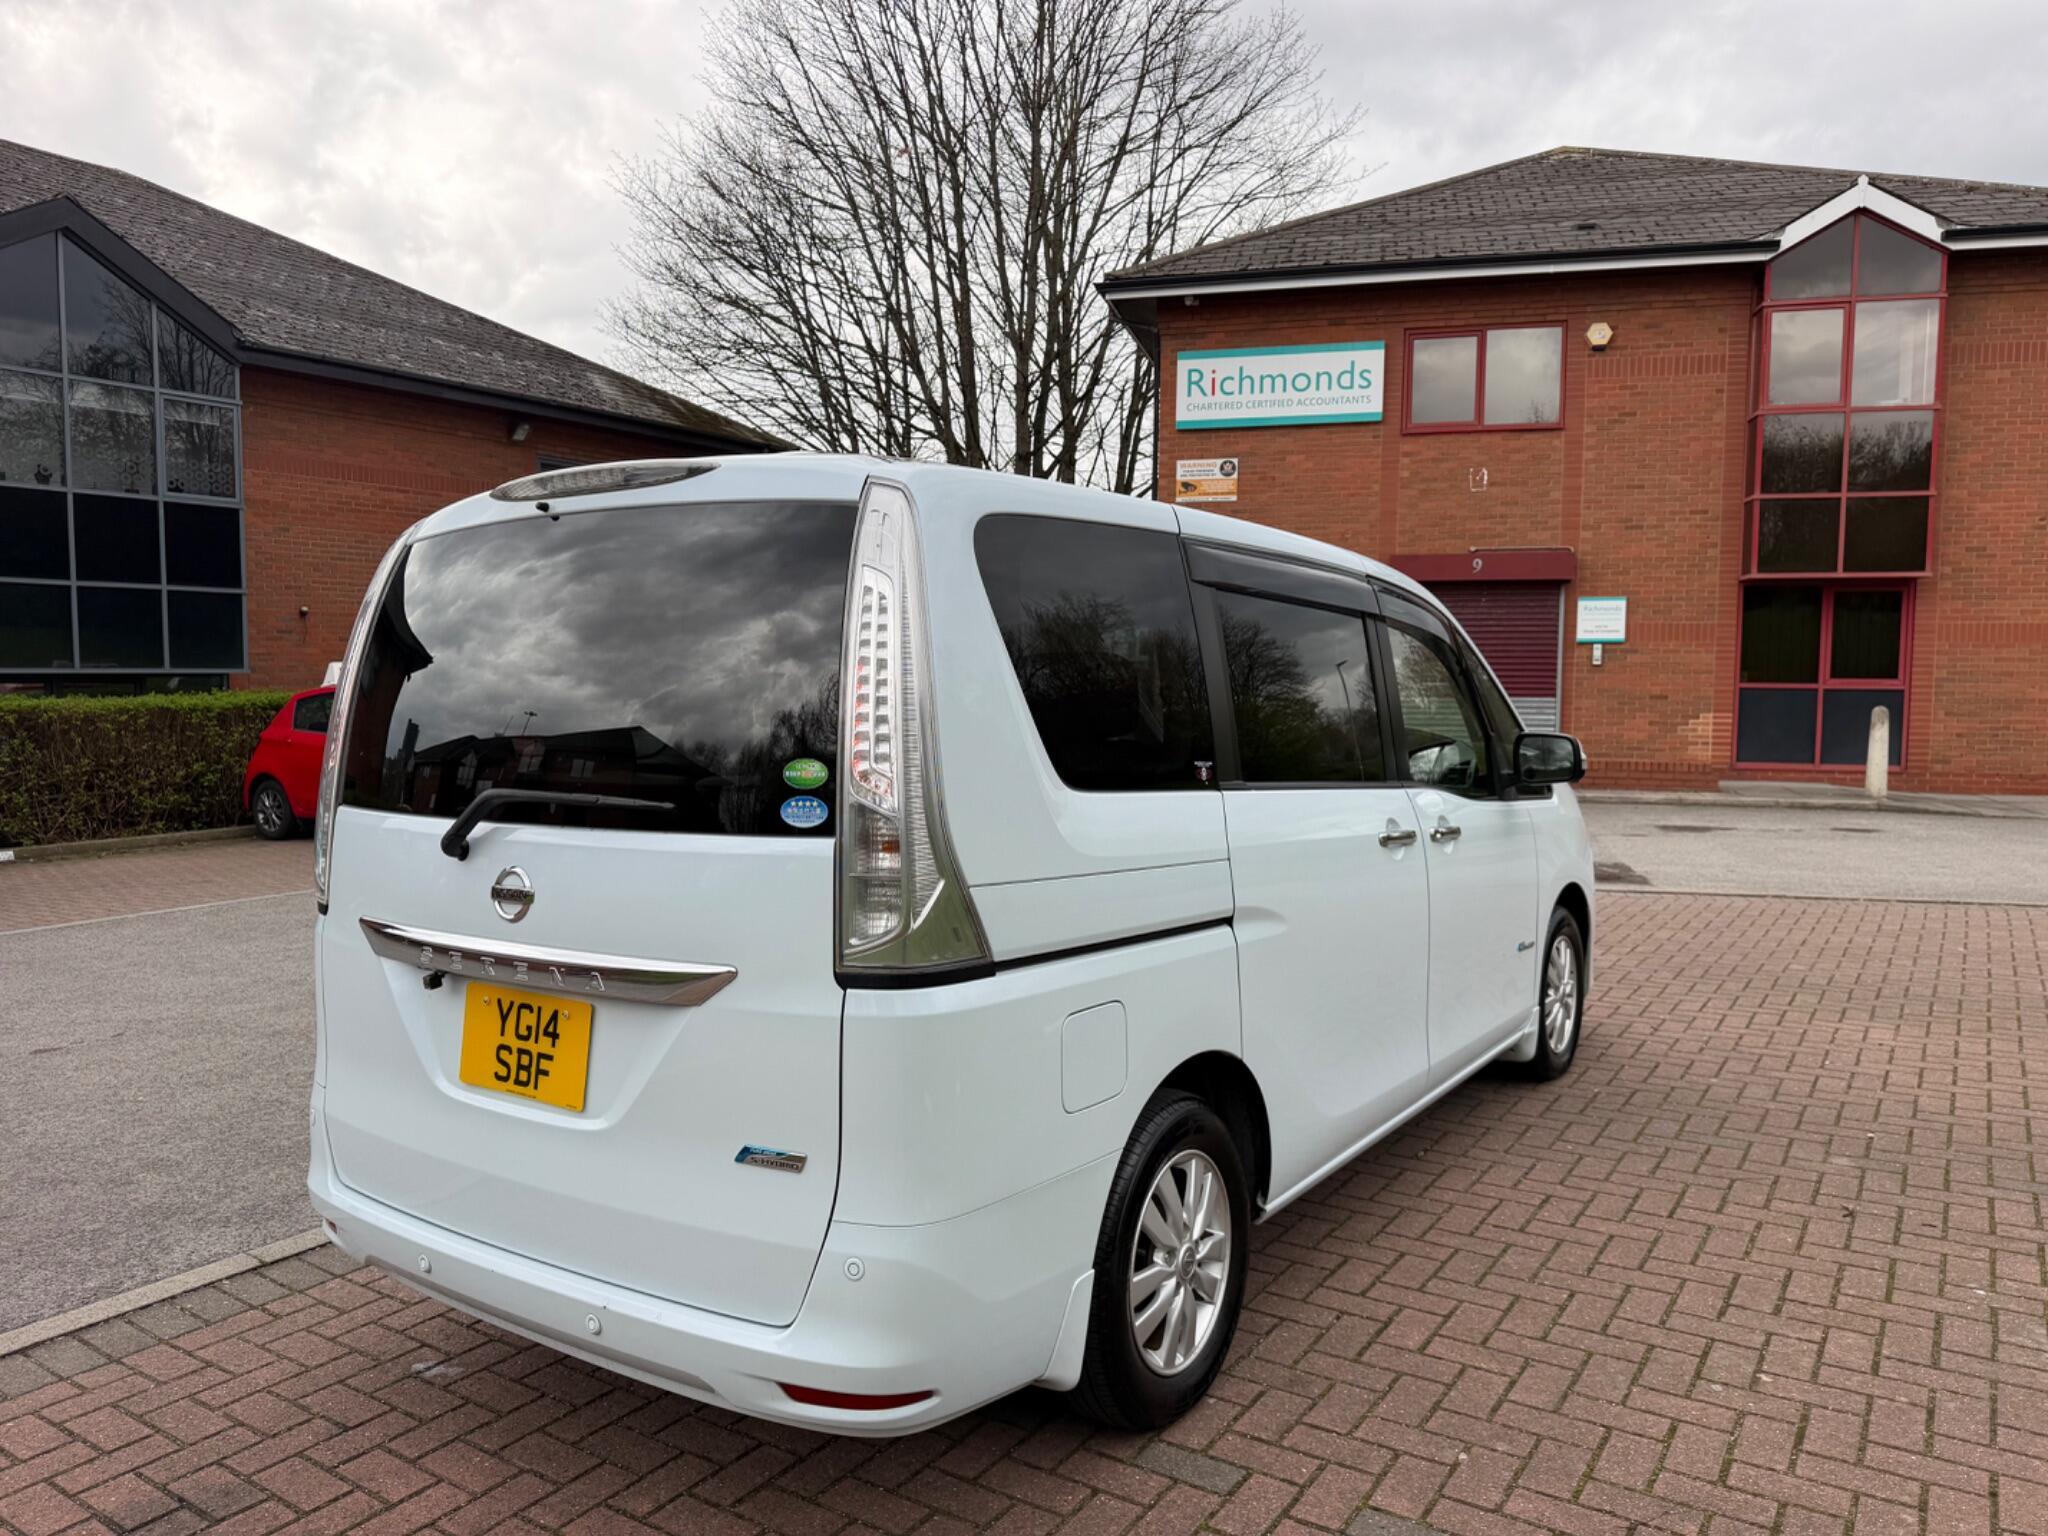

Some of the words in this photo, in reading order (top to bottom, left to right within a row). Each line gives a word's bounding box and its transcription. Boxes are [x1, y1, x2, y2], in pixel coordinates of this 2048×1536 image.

[1187, 360, 1372, 398] Richmonds
[1186, 401, 1243, 412] CHARTERED
[1245, 398, 1293, 409] CERTIFIED
[1295, 394, 1372, 407] ACCOUNTANTS
[1472, 558, 1483, 574] 9
[496, 997, 560, 1049] YG14
[494, 1043, 555, 1091] SBF
